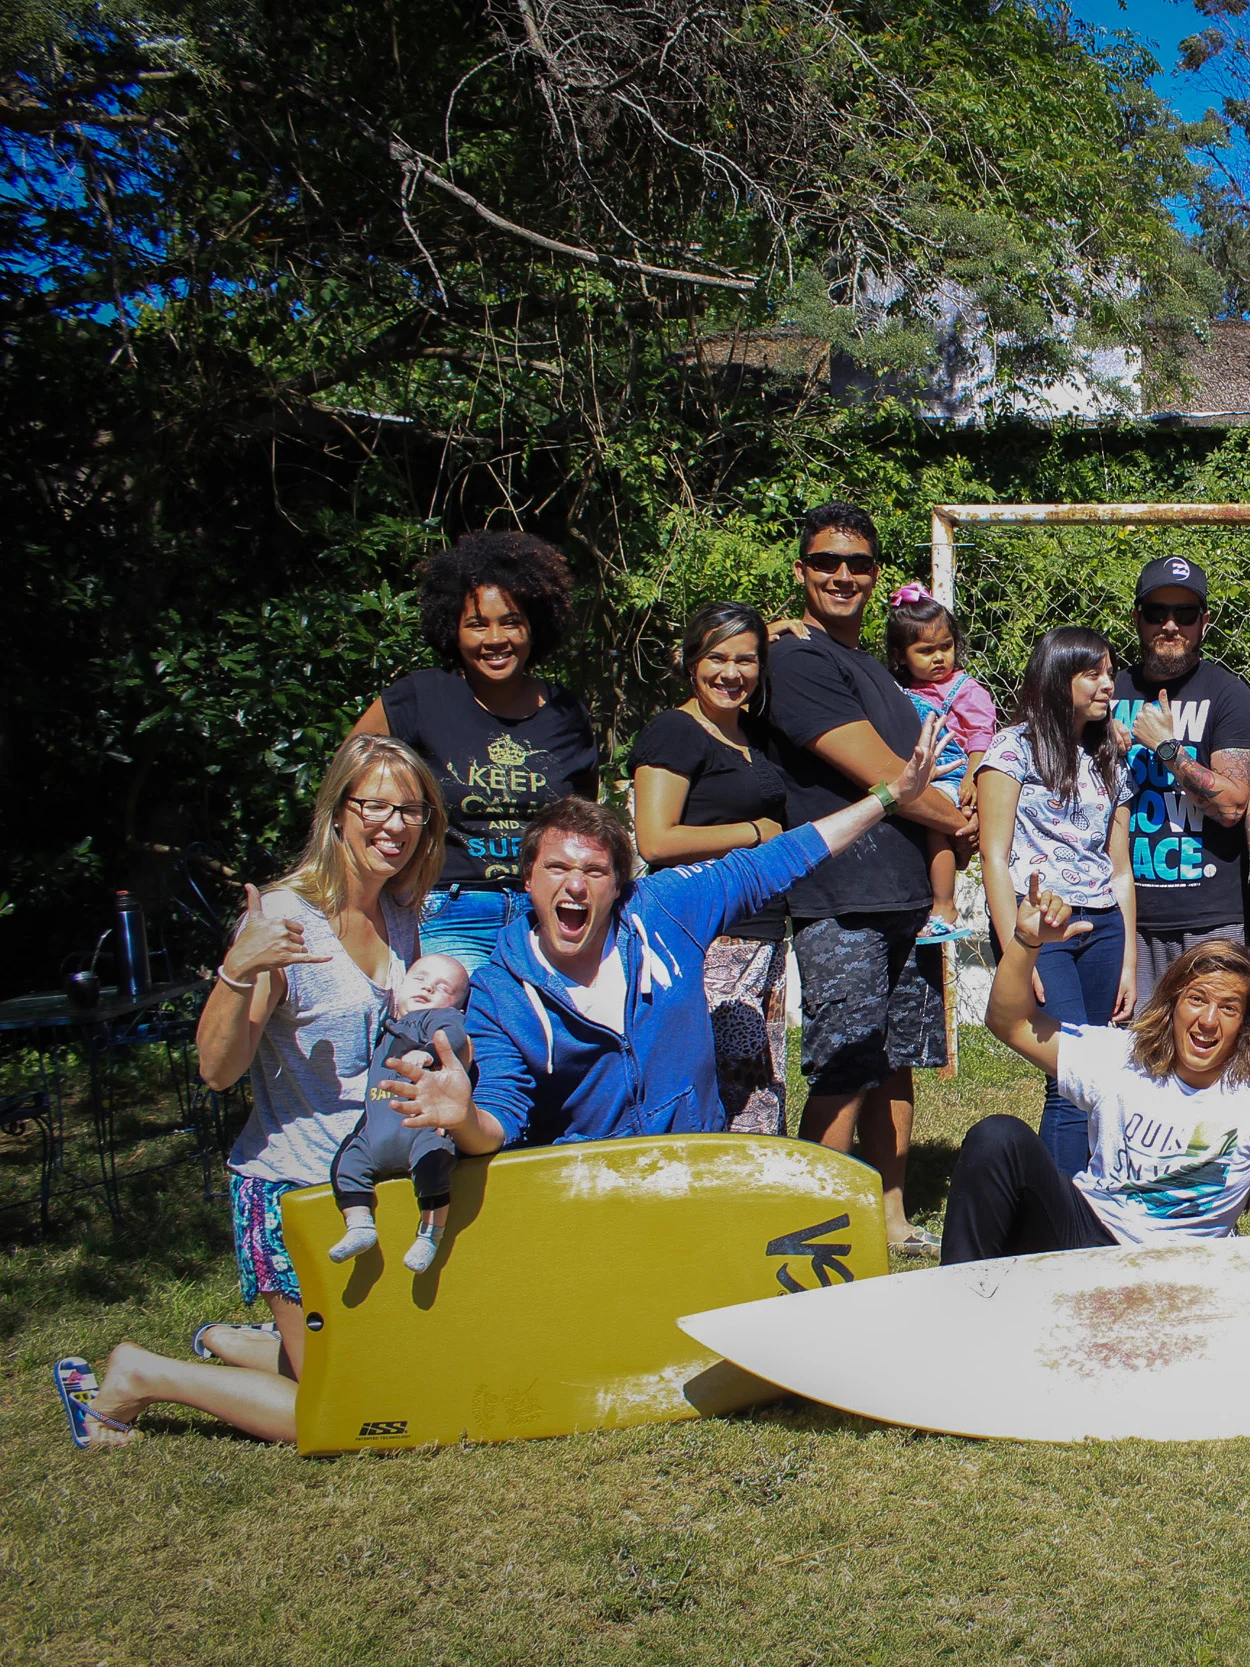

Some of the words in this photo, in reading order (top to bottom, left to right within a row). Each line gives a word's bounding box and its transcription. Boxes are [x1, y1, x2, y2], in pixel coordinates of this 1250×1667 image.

[468, 766, 547, 794] KEEP
[489, 820, 521, 830] AND
[1128, 837, 1217, 881] ACE.
